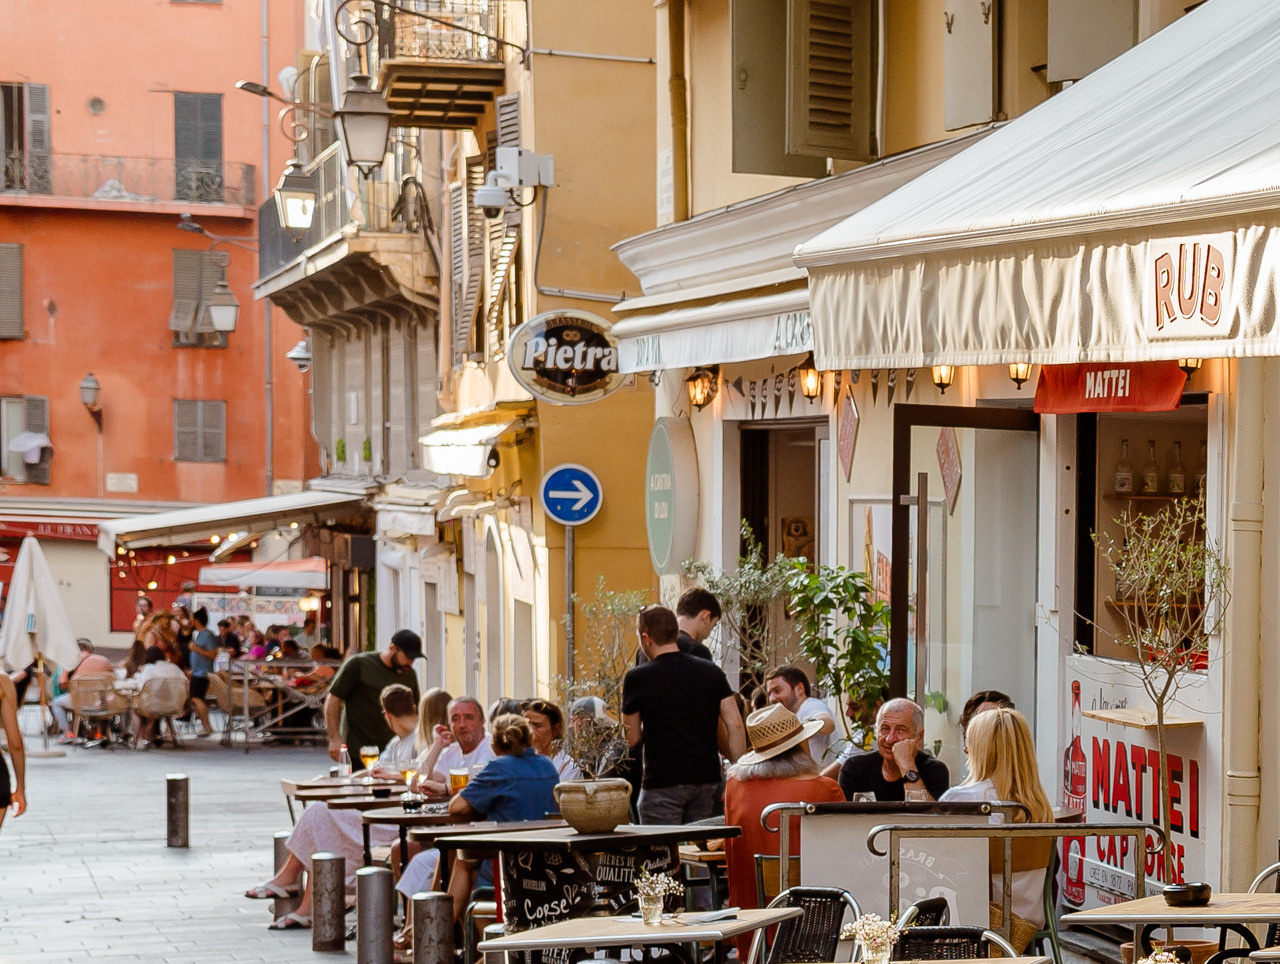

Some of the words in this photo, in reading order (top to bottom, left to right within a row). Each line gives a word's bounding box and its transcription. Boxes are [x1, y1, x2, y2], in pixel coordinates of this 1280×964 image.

[1155, 243, 1225, 332] RUB
[521, 336, 618, 372] Pietra
[1085, 369, 1131, 399] MATTEI
[1092, 736, 1200, 840] MATTEI
